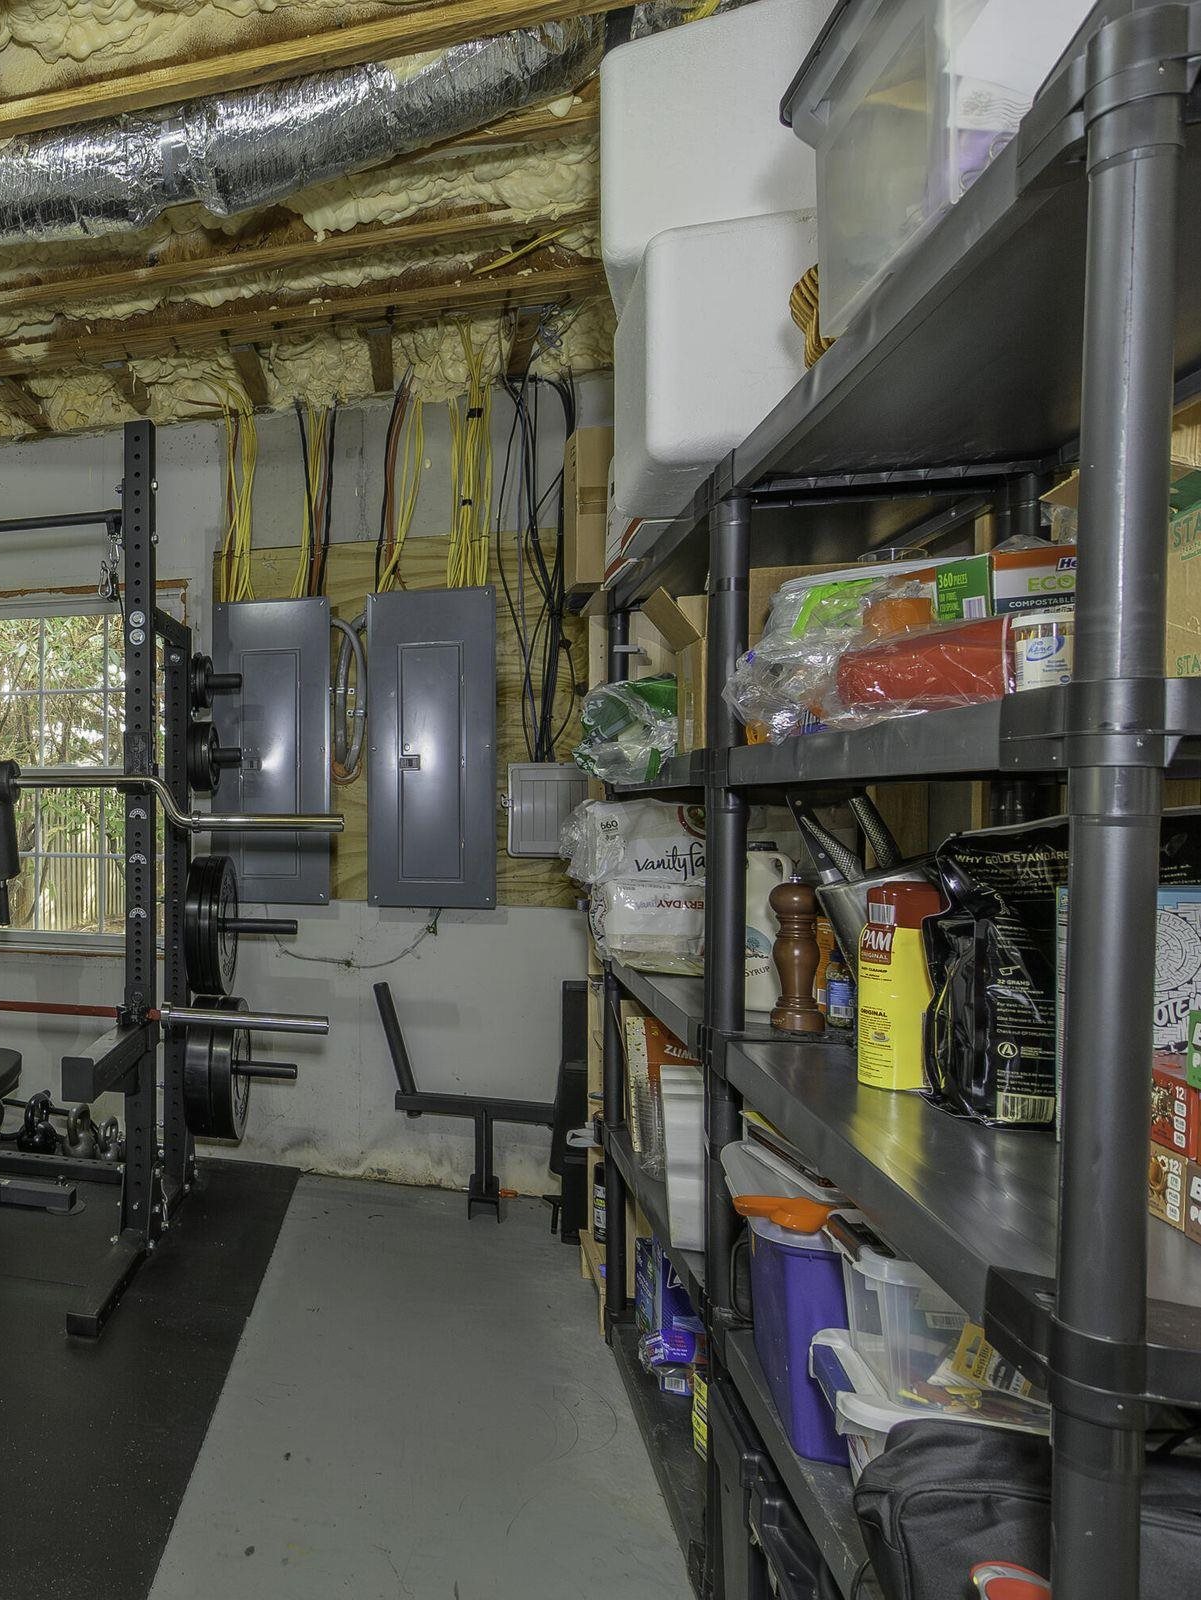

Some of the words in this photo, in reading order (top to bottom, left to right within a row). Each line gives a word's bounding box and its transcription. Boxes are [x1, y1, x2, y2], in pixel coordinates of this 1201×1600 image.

[938, 573, 953, 588] 360
[1008, 595, 1076, 609] COMPOSTABLE
[601, 820, 618, 830] 660
[955, 853, 982, 864] WHY
[985, 854, 1011, 865] GOLD
[861, 929, 892, 952] PAM
[860, 1007, 888, 1018] ORIGINAL
[1175, 1086, 1185, 1100] 12
